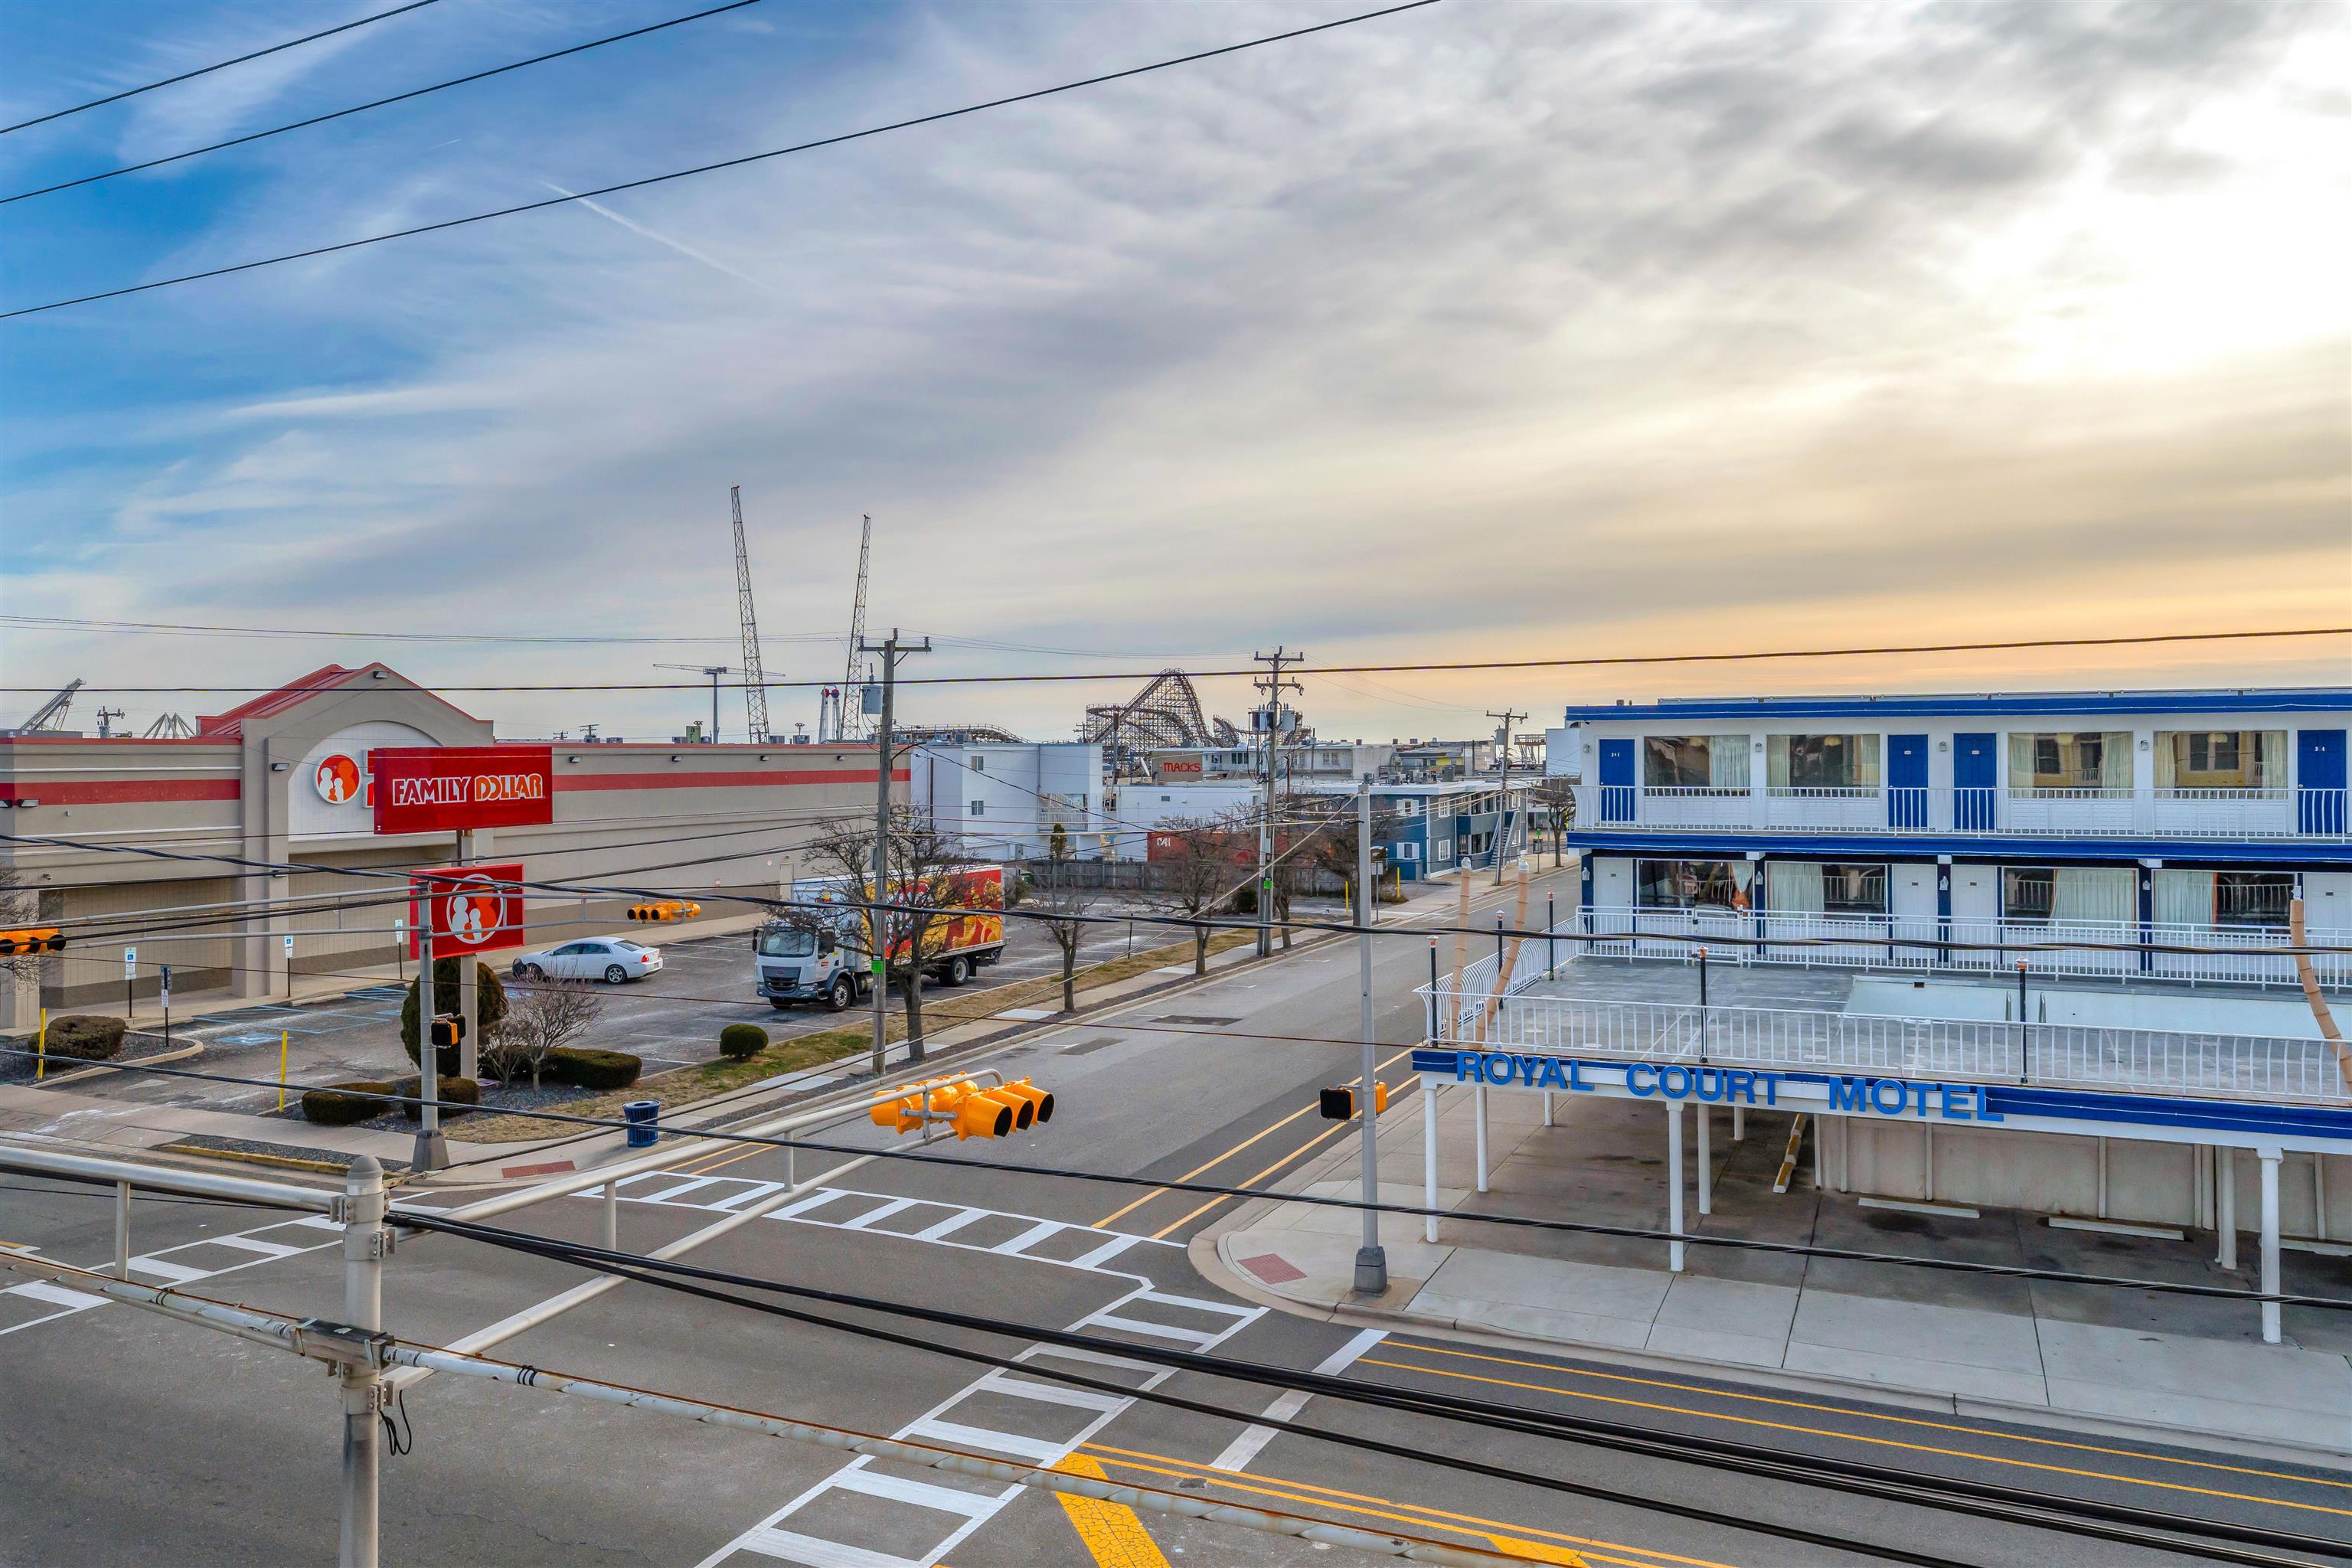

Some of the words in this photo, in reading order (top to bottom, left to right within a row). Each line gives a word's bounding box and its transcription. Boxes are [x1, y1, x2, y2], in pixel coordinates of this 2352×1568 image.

[1163, 762, 1201, 773] MACKS
[392, 776, 472, 806] FAMILY
[474, 773, 544, 802] DOLLAR
[1456, 1050, 1595, 1092] ROYAL
[1626, 1063, 1786, 1106] COURT
[1828, 1076, 2004, 1122] MOTEL
